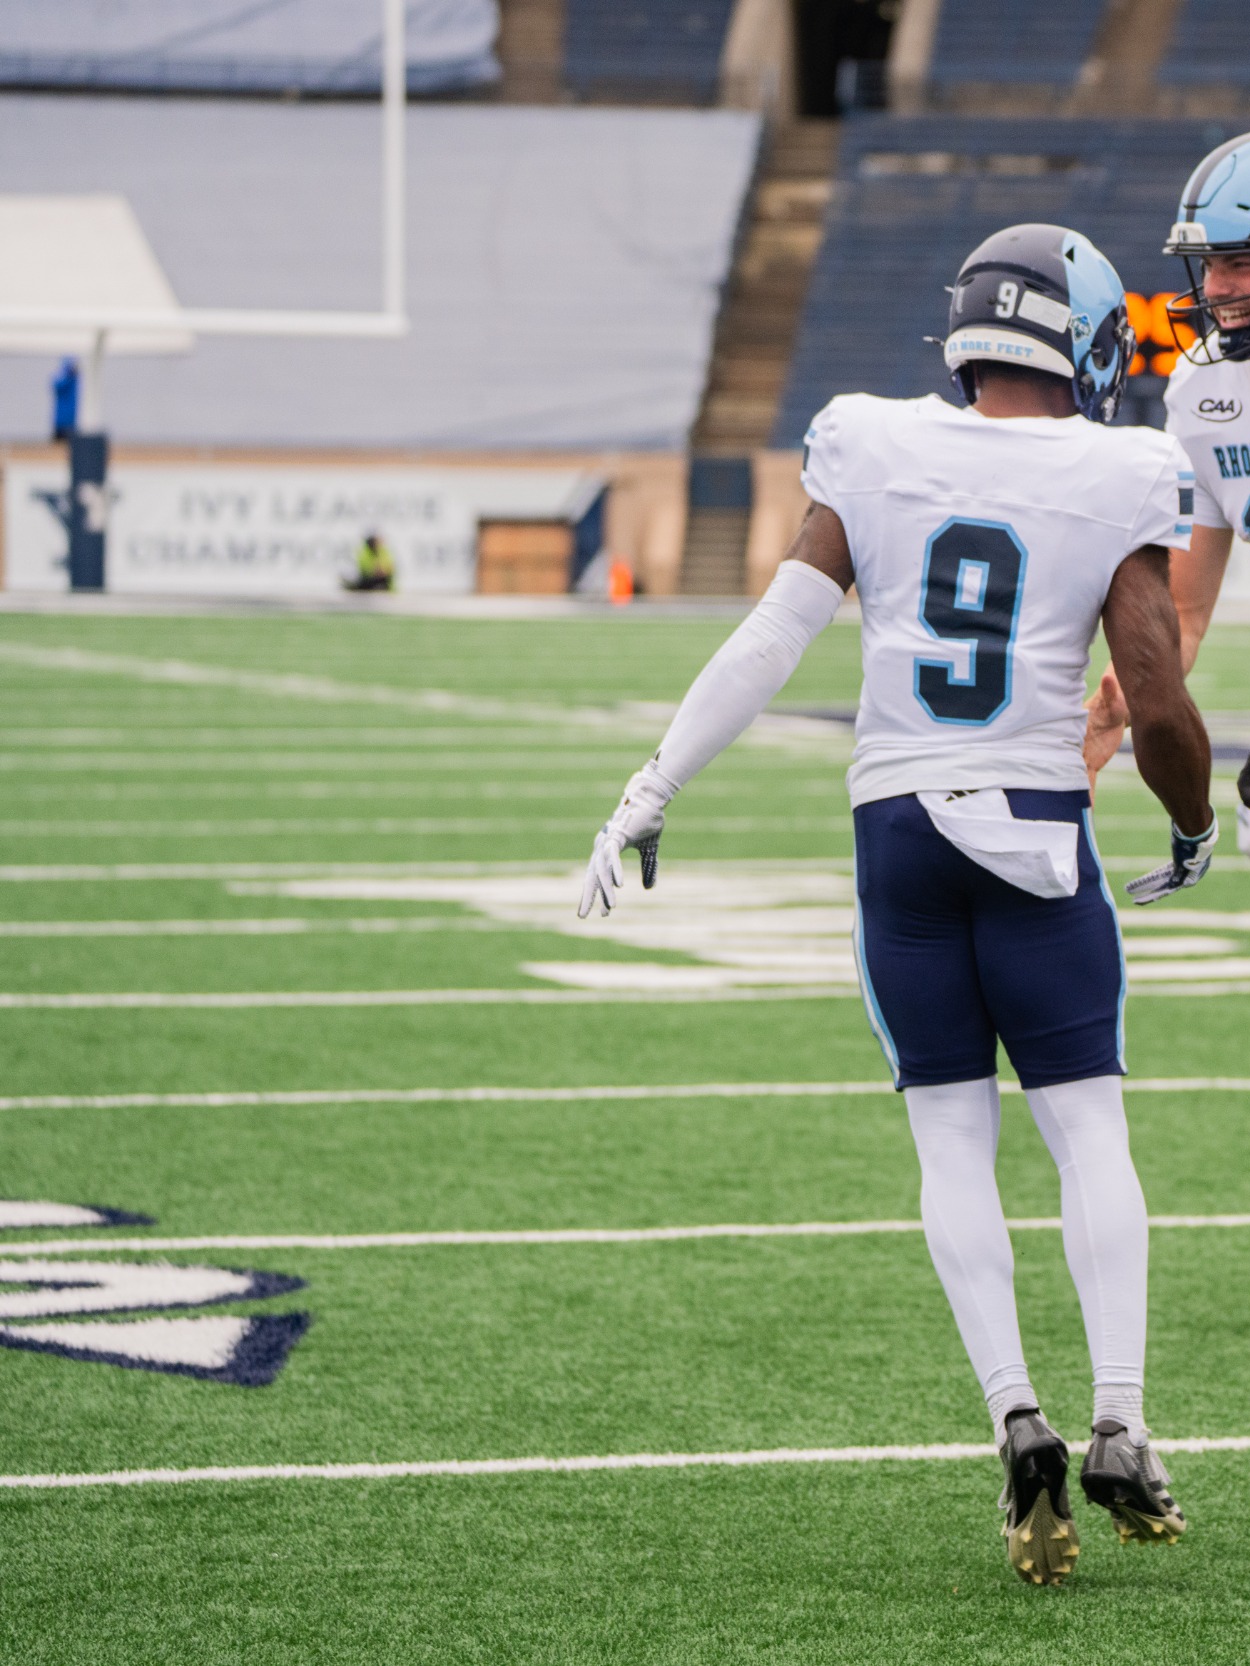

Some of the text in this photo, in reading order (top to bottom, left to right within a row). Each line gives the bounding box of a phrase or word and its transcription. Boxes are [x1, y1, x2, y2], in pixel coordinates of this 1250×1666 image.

[996, 281, 1018, 318] 9
[961, 340, 991, 353] MORE
[997, 342, 1034, 357] FEET
[1198, 398, 1236, 414] CAA
[913, 516, 1028, 726] 9
